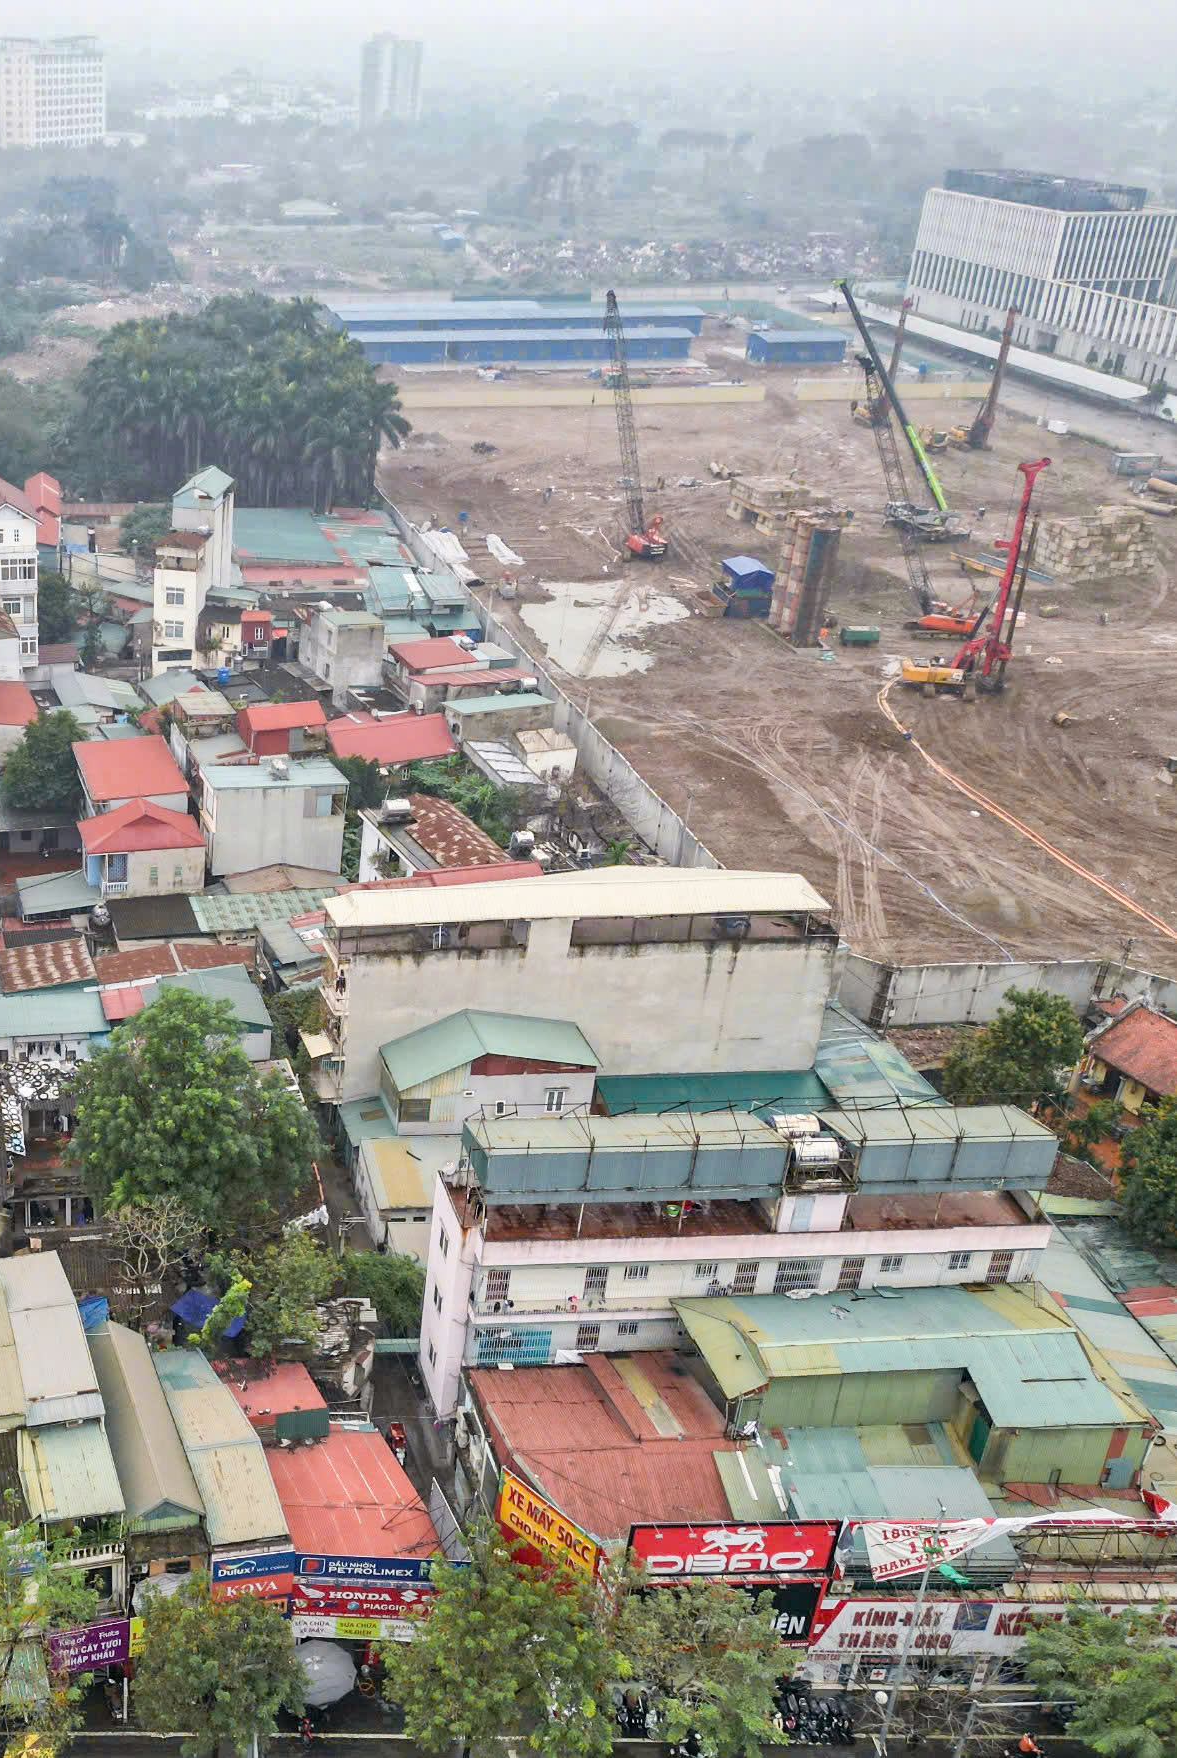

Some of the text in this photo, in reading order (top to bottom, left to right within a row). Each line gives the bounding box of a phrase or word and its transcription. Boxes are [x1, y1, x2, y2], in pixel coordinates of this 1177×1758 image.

[508, 1485, 525, 1511] XE
[557, 1524, 592, 1563] 50CC
[510, 1512, 532, 1535] CHO
[218, 1567, 251, 1577] Dulux
[328, 1566, 414, 1577] PETROLIMEX
[226, 1581, 277, 1598] KOVA
[329, 1591, 392, 1601] HONDA
[363, 1603, 407, 1612] PIAGGIO
